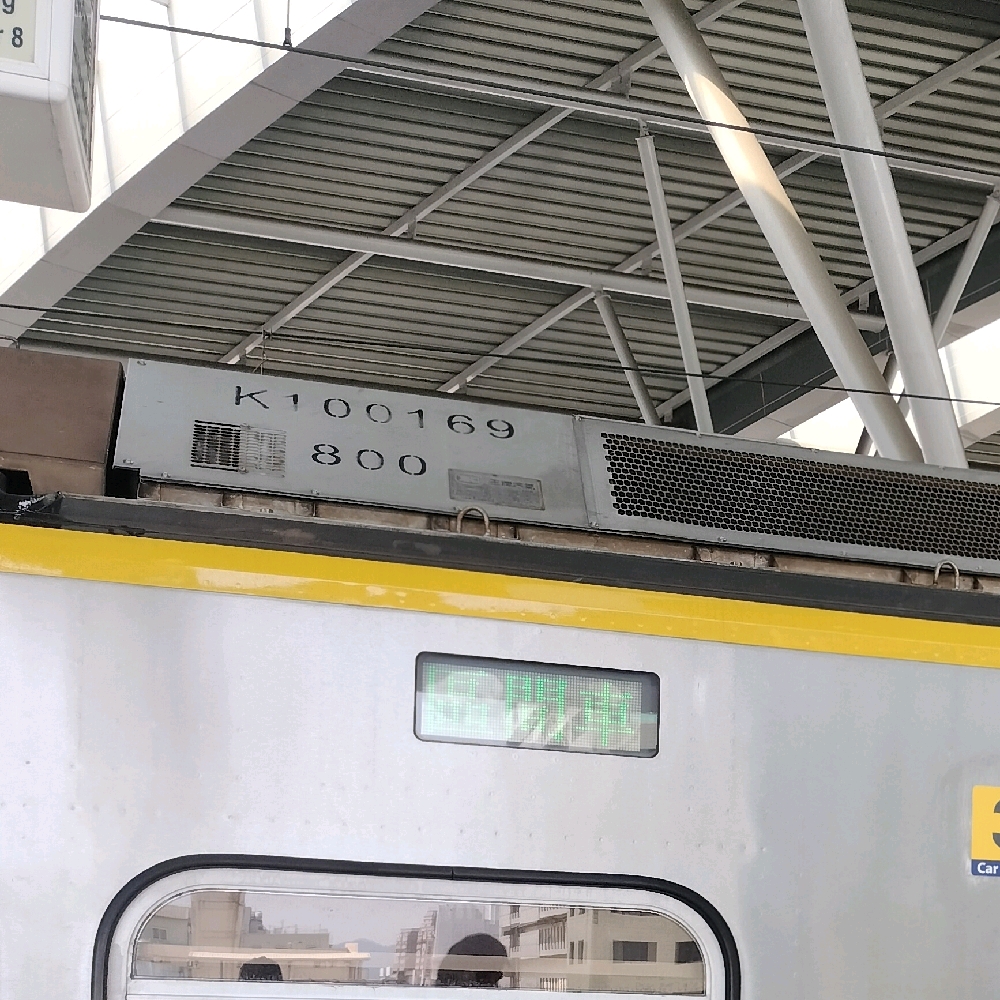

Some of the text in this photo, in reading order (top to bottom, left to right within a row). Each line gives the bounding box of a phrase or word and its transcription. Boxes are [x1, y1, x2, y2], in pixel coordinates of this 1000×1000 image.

[234, 385, 515, 439] K100169
[311, 443, 427, 476] 800
[977, 862, 999, 875] Car
